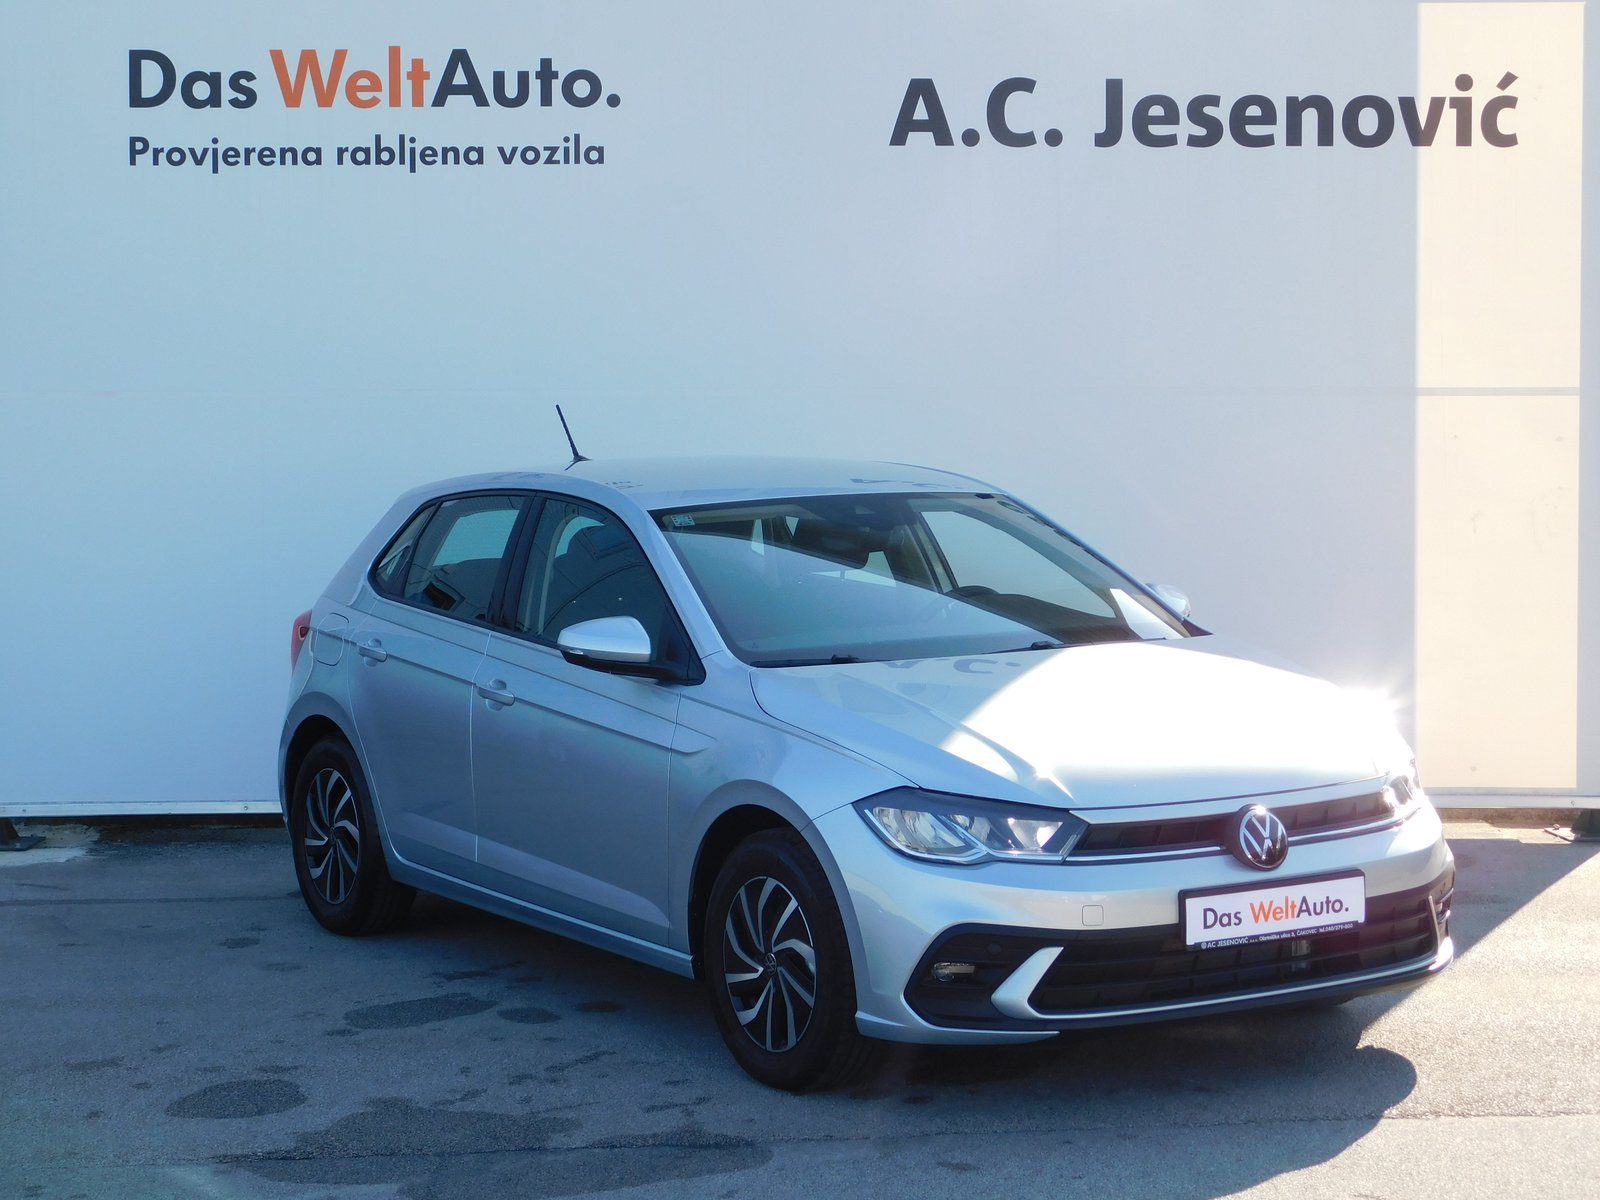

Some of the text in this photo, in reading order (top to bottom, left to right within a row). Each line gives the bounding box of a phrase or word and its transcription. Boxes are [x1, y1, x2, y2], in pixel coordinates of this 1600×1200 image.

[128, 45, 622, 110] Das WeltAuto.
[888, 71, 1519, 149] A.C. Jesenović
[128, 133, 605, 175] Provjerena rabljena vozila
[1203, 895, 1350, 930] Das WeltAuto.
[1217, 936, 1249, 948] JESENOVIĆ
